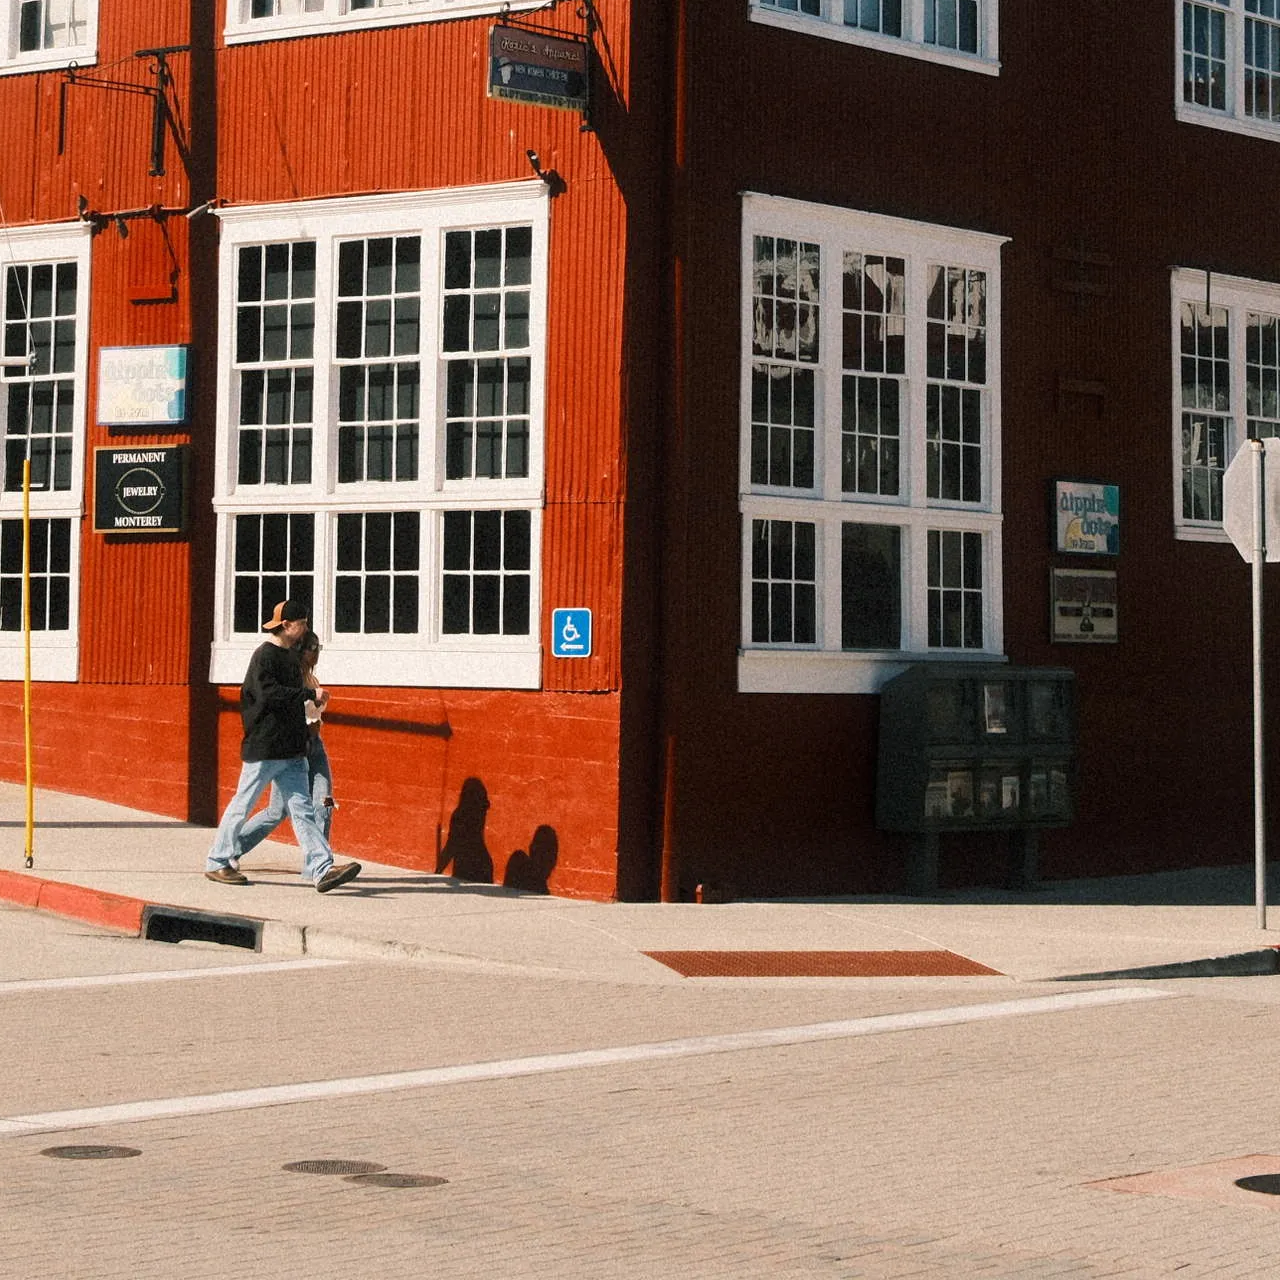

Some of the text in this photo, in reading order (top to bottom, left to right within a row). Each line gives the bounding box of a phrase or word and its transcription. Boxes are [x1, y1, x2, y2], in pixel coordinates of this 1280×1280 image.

[112, 452, 166, 464] PERMANENT
[123, 486, 159, 498] JEWELRY
[115, 516, 163, 528] MONTEREY
